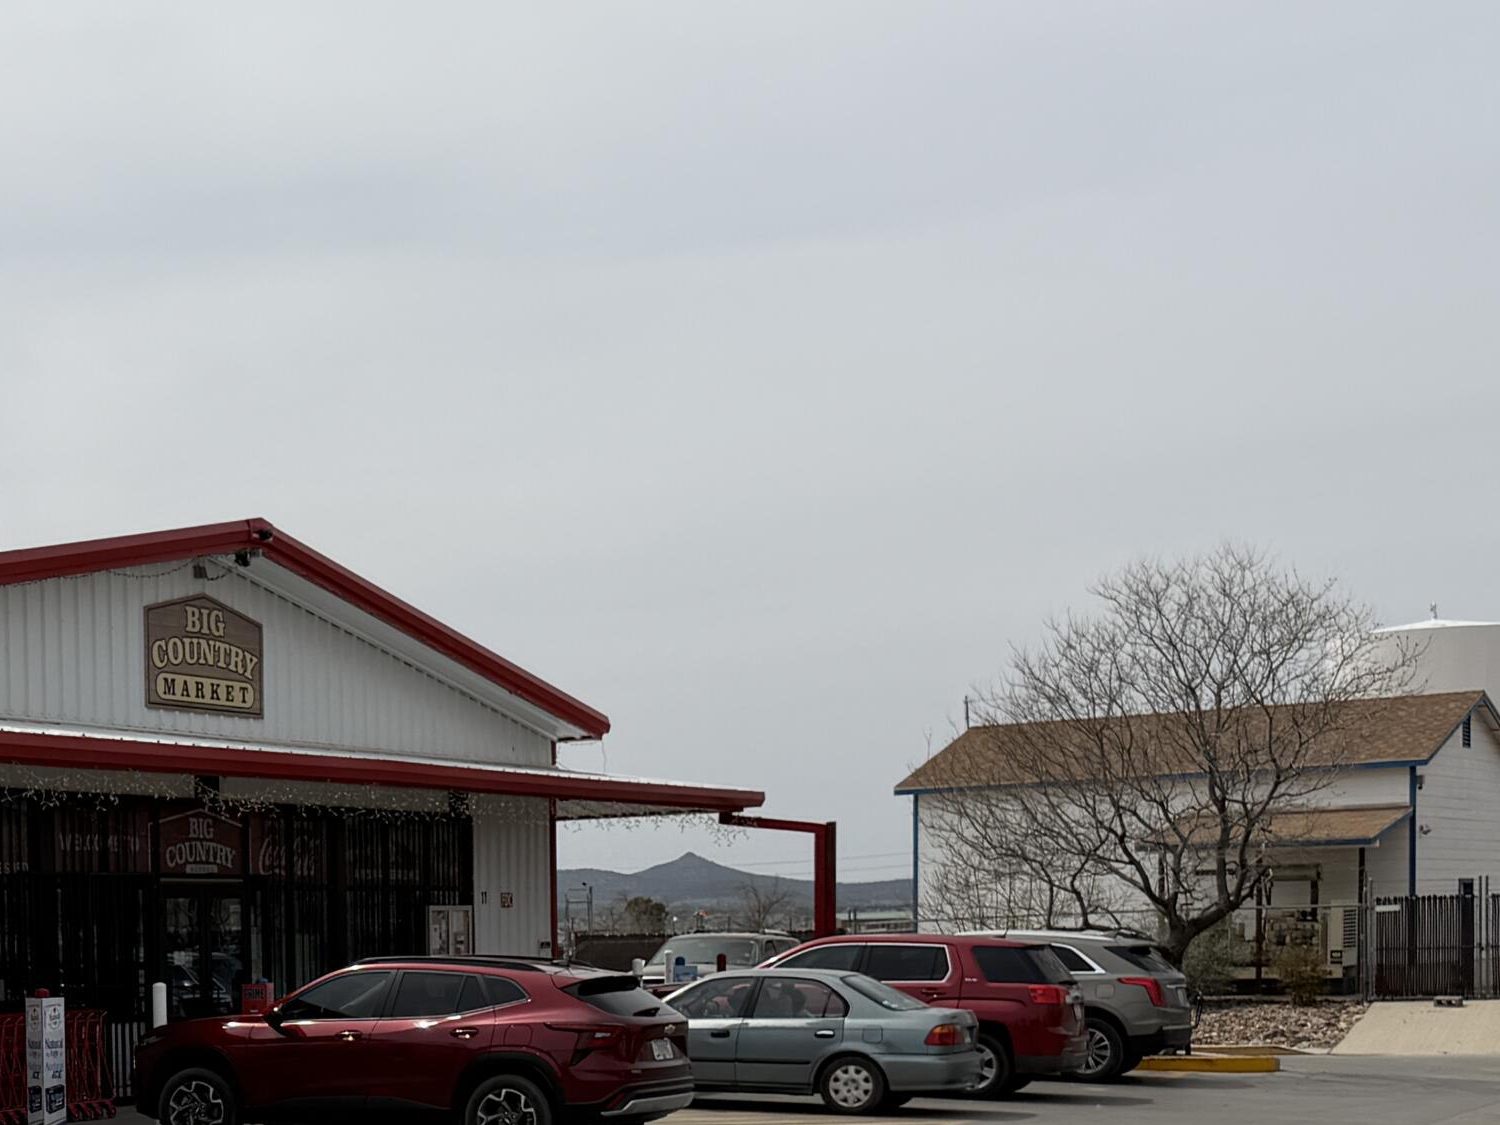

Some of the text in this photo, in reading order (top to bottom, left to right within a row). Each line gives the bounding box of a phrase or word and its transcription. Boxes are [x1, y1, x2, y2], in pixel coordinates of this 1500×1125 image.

[185, 605, 225, 637] BIG
[152, 638, 258, 679] COUNTRY
[163, 677, 248, 704] MARKET
[189, 817, 214, 839] BIG
[166, 841, 236, 868] COUNTRY
